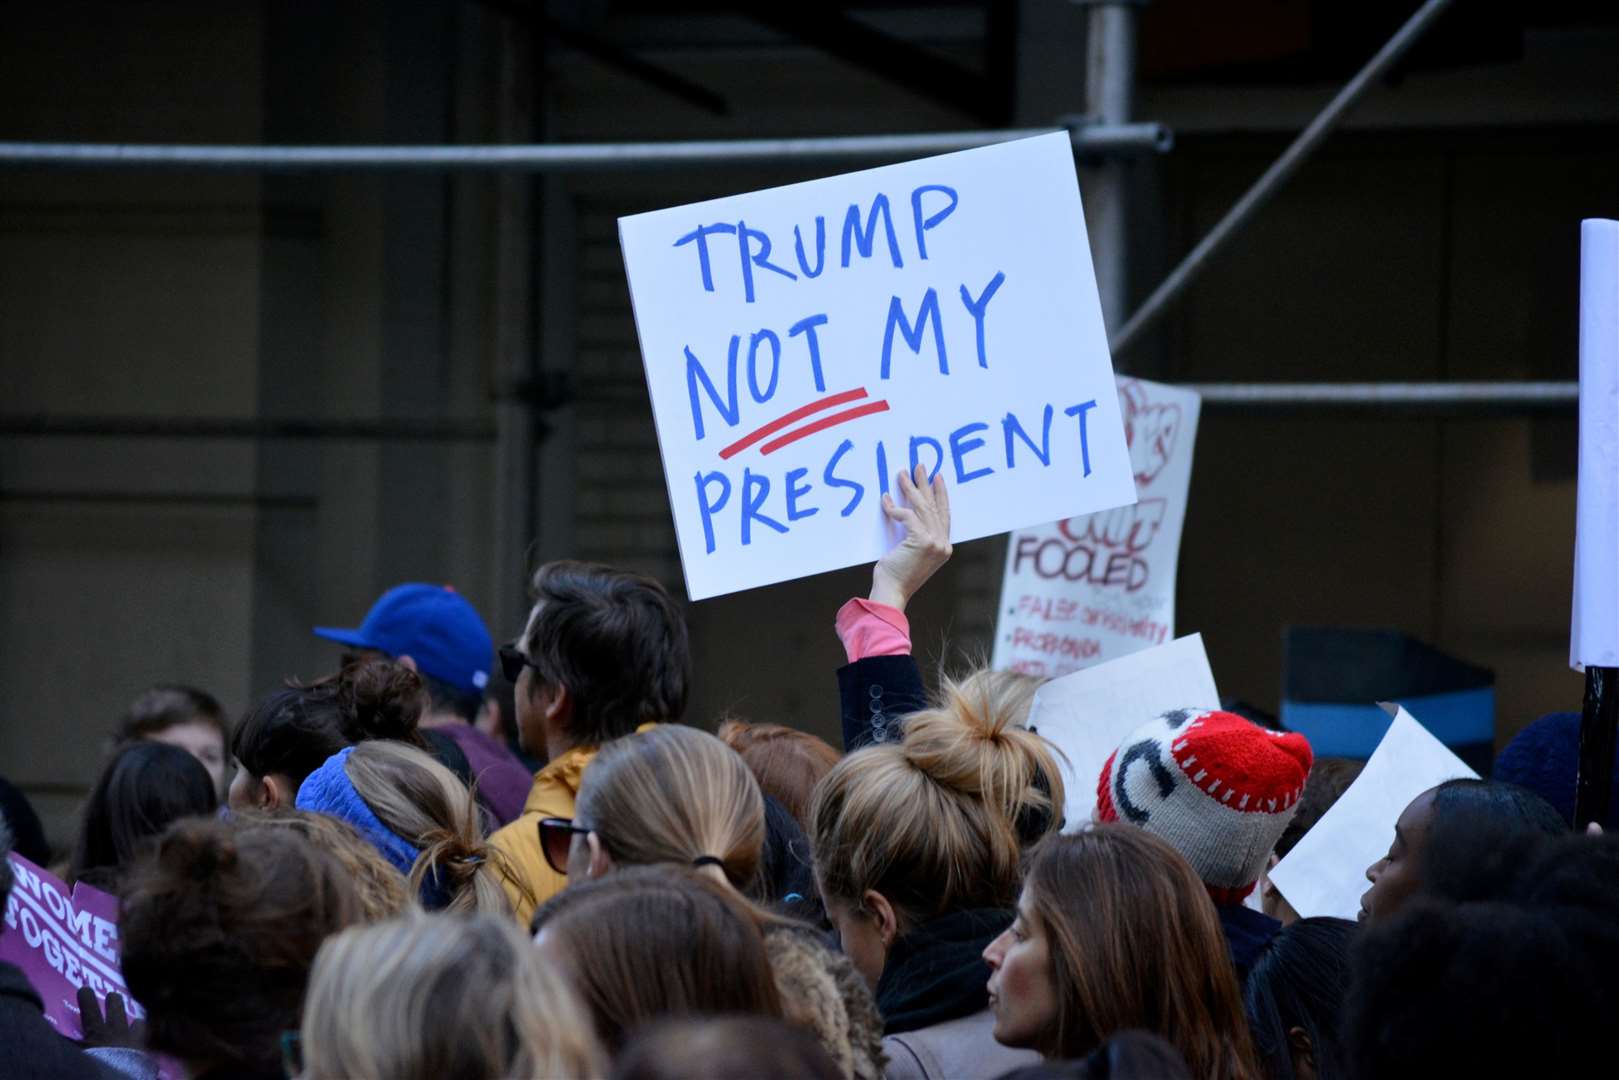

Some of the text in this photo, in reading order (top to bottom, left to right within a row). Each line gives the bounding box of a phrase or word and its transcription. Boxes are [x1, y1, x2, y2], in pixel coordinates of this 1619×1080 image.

[672, 184, 959, 304] TRUMP
[682, 271, 1006, 441] NOT MY
[693, 399, 1097, 556] PRESIDENT
[1014, 537, 1149, 593] FOOLED
[7, 857, 121, 966] WOME
